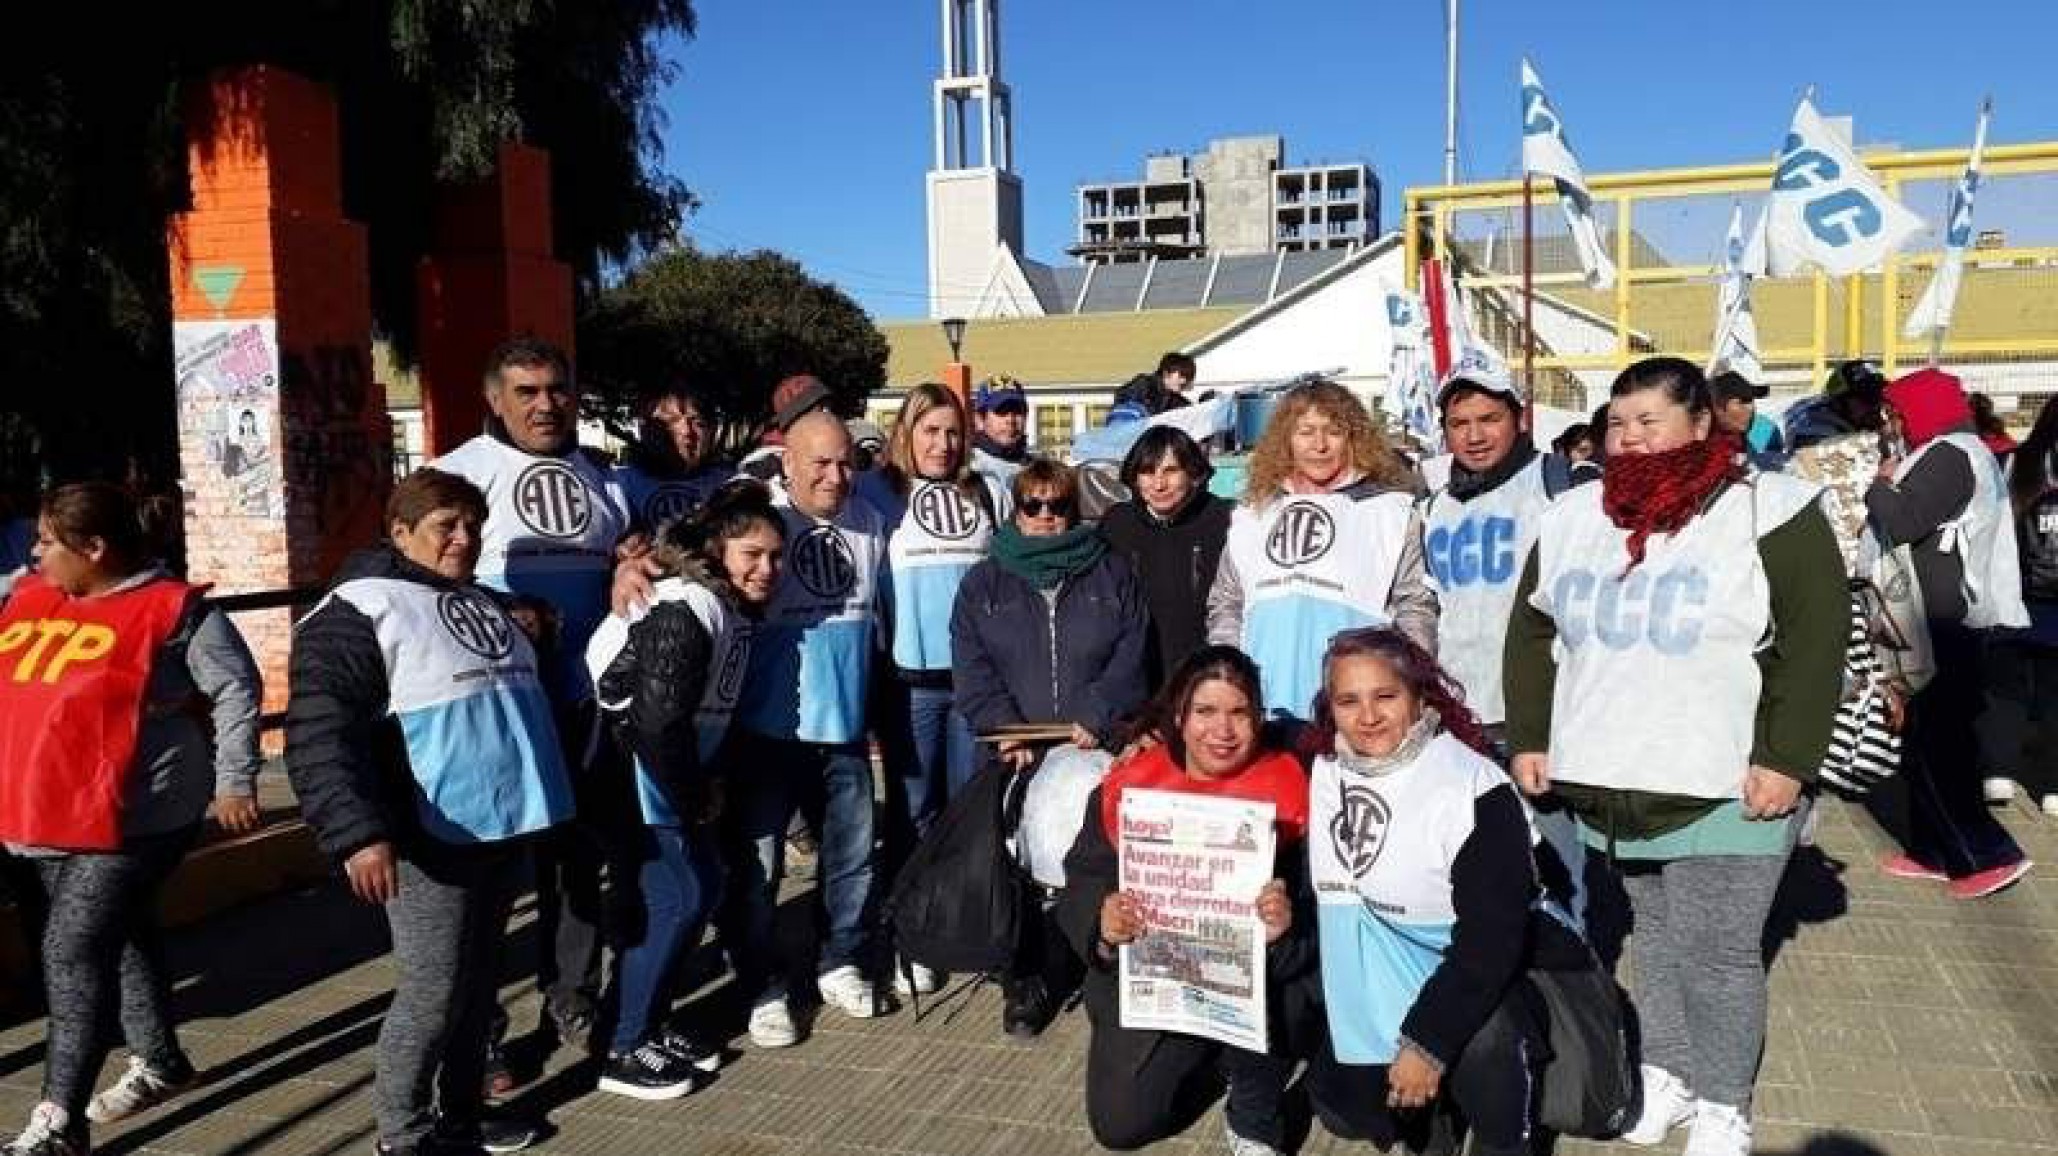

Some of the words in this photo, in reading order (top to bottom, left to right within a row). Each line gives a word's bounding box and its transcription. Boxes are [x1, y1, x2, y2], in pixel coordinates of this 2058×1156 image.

[522, 469, 587, 534] ATE
[919, 489, 974, 534] ATE
[800, 533, 856, 591] ATE
[1272, 506, 1327, 562] ATE
[448, 597, 509, 653] ATE
[1554, 568, 1708, 656] CCC
[1124, 845, 1204, 871] Avanzar
[1209, 856, 1235, 873] en
[1144, 869, 1214, 892] unidad
[1170, 886, 1252, 917] derrotar
